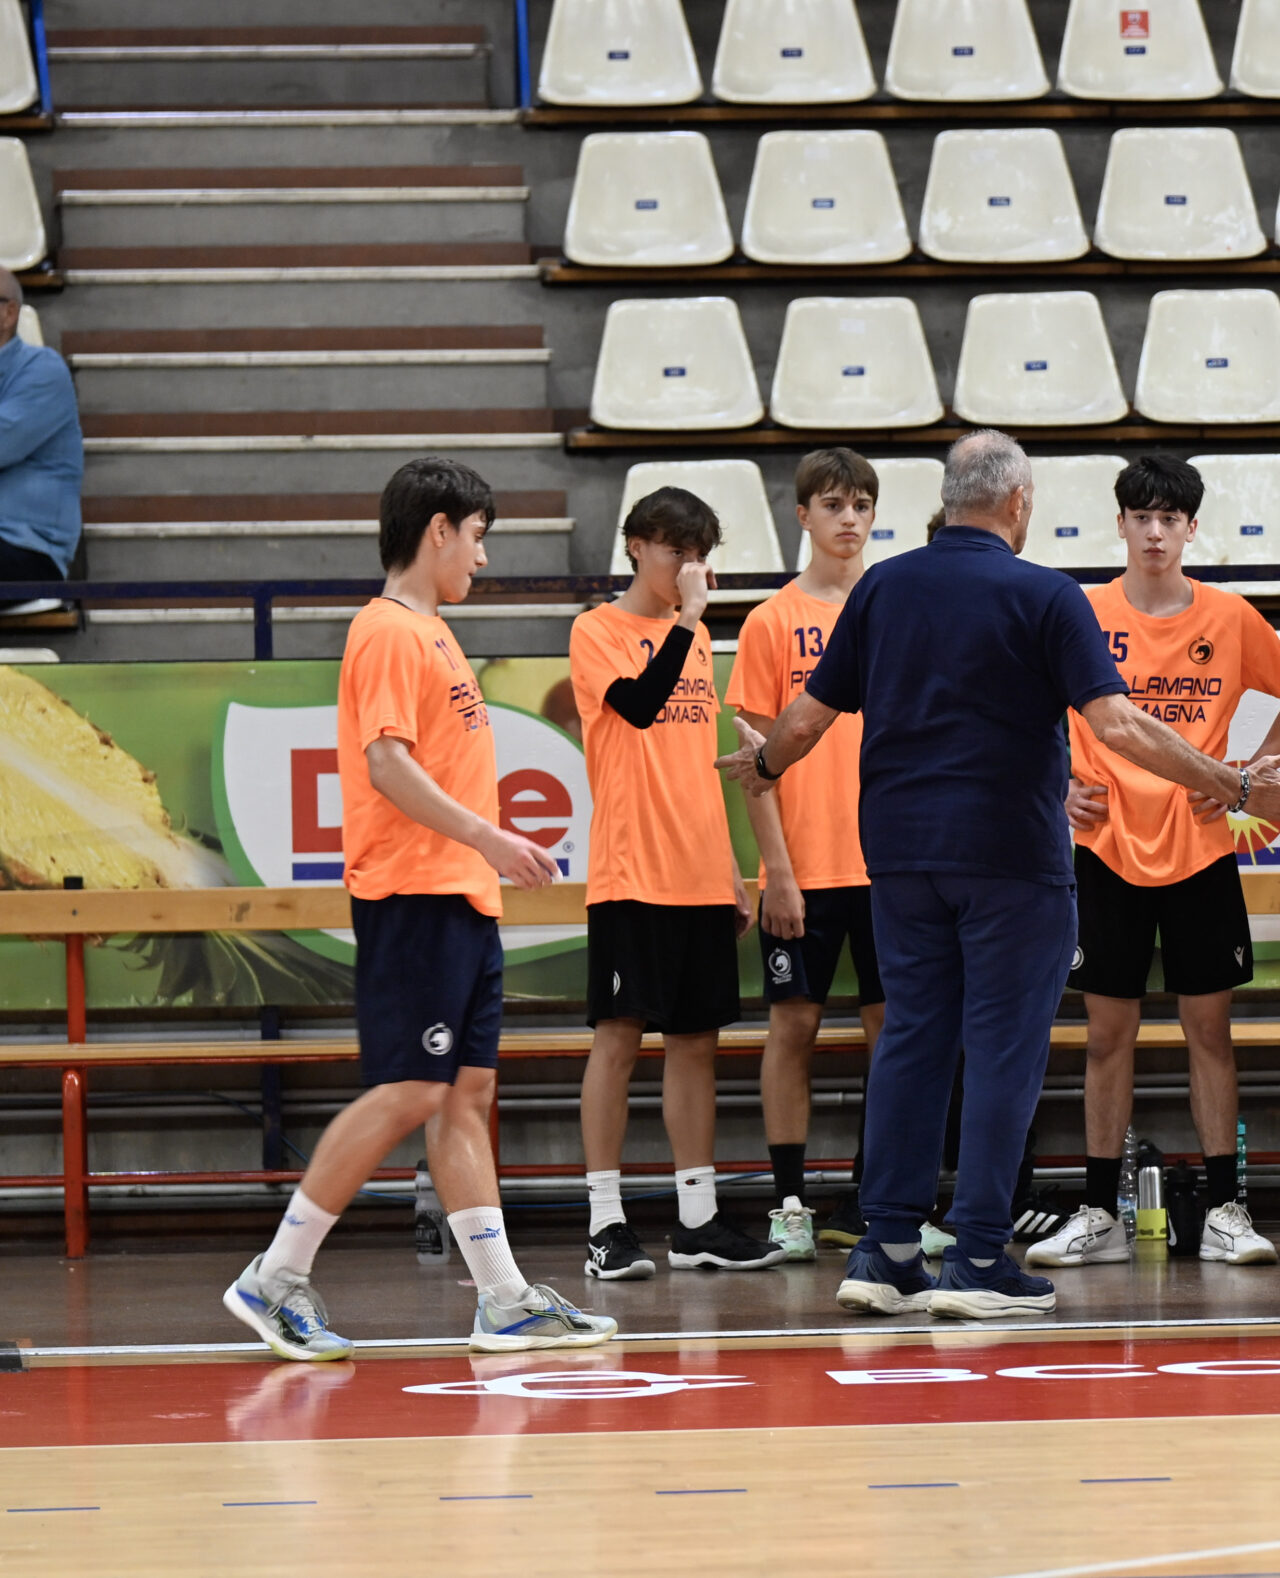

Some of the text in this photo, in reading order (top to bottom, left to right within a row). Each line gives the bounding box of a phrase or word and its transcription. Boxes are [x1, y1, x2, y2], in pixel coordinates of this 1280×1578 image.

[794, 626, 825, 657] 13
[1131, 675, 1222, 696] LAMANO
[290, 747, 573, 854] De
